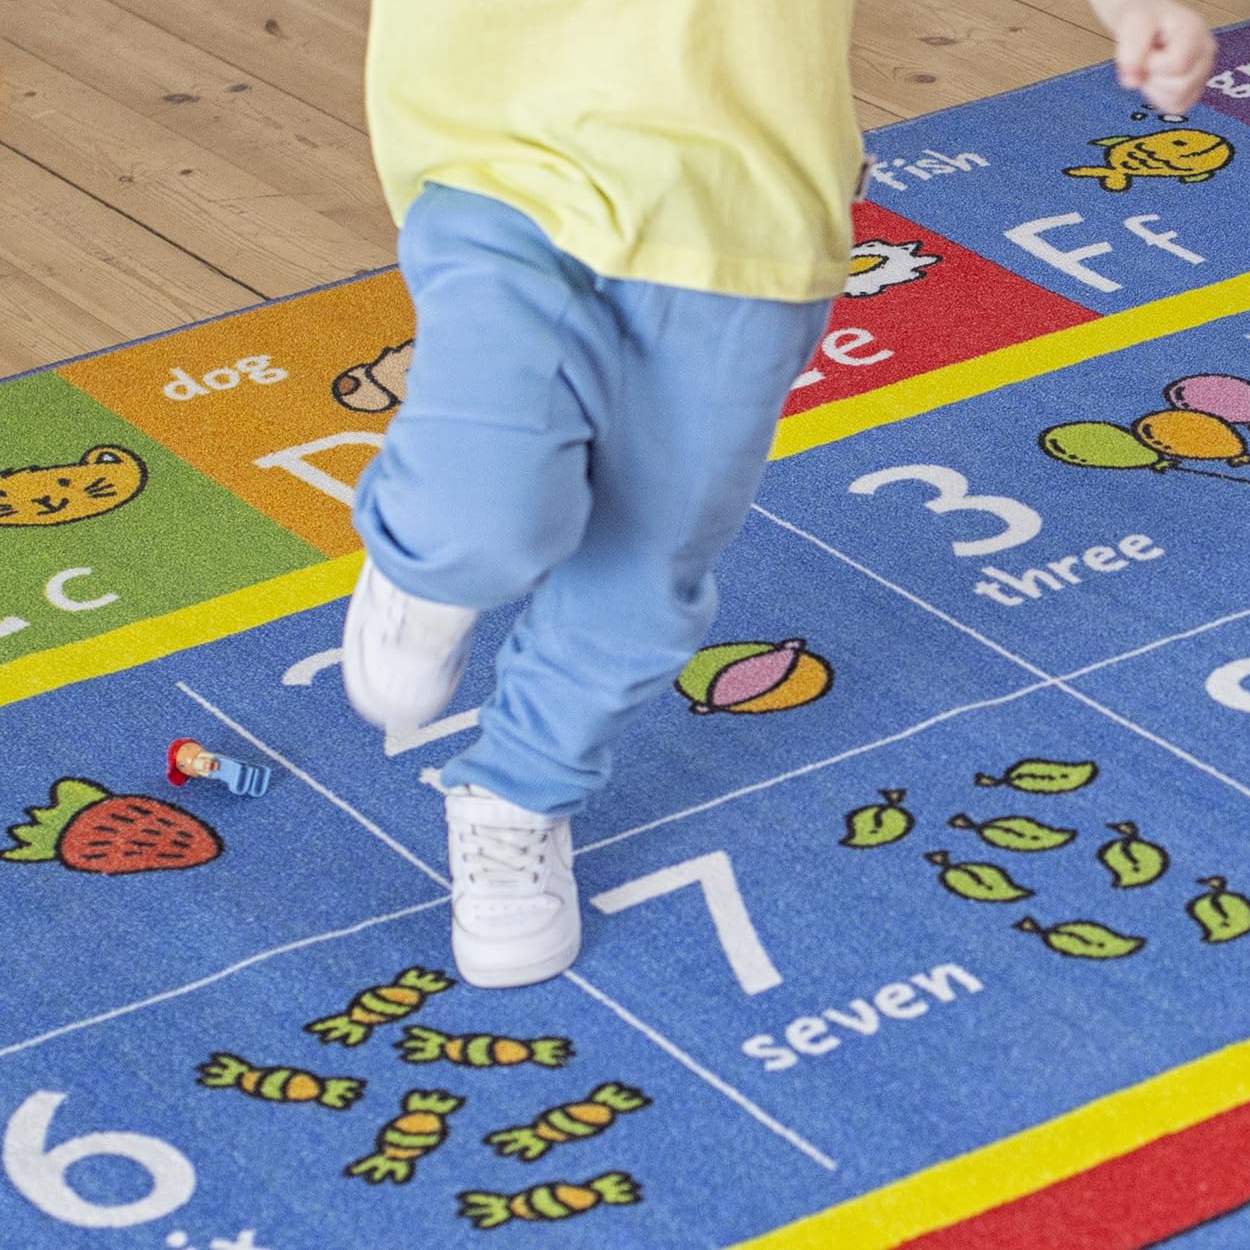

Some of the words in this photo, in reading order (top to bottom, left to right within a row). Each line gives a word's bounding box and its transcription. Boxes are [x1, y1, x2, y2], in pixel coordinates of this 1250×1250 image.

[870, 149, 990, 191] fish
[1004, 212, 1206, 293] Ff
[163, 354, 288, 401] dog
[848, 464, 1043, 557] 3
[973, 532, 1166, 608] three
[589, 849, 783, 996] 7
[741, 962, 984, 1071] seven
[2, 1089, 197, 1229] 6
